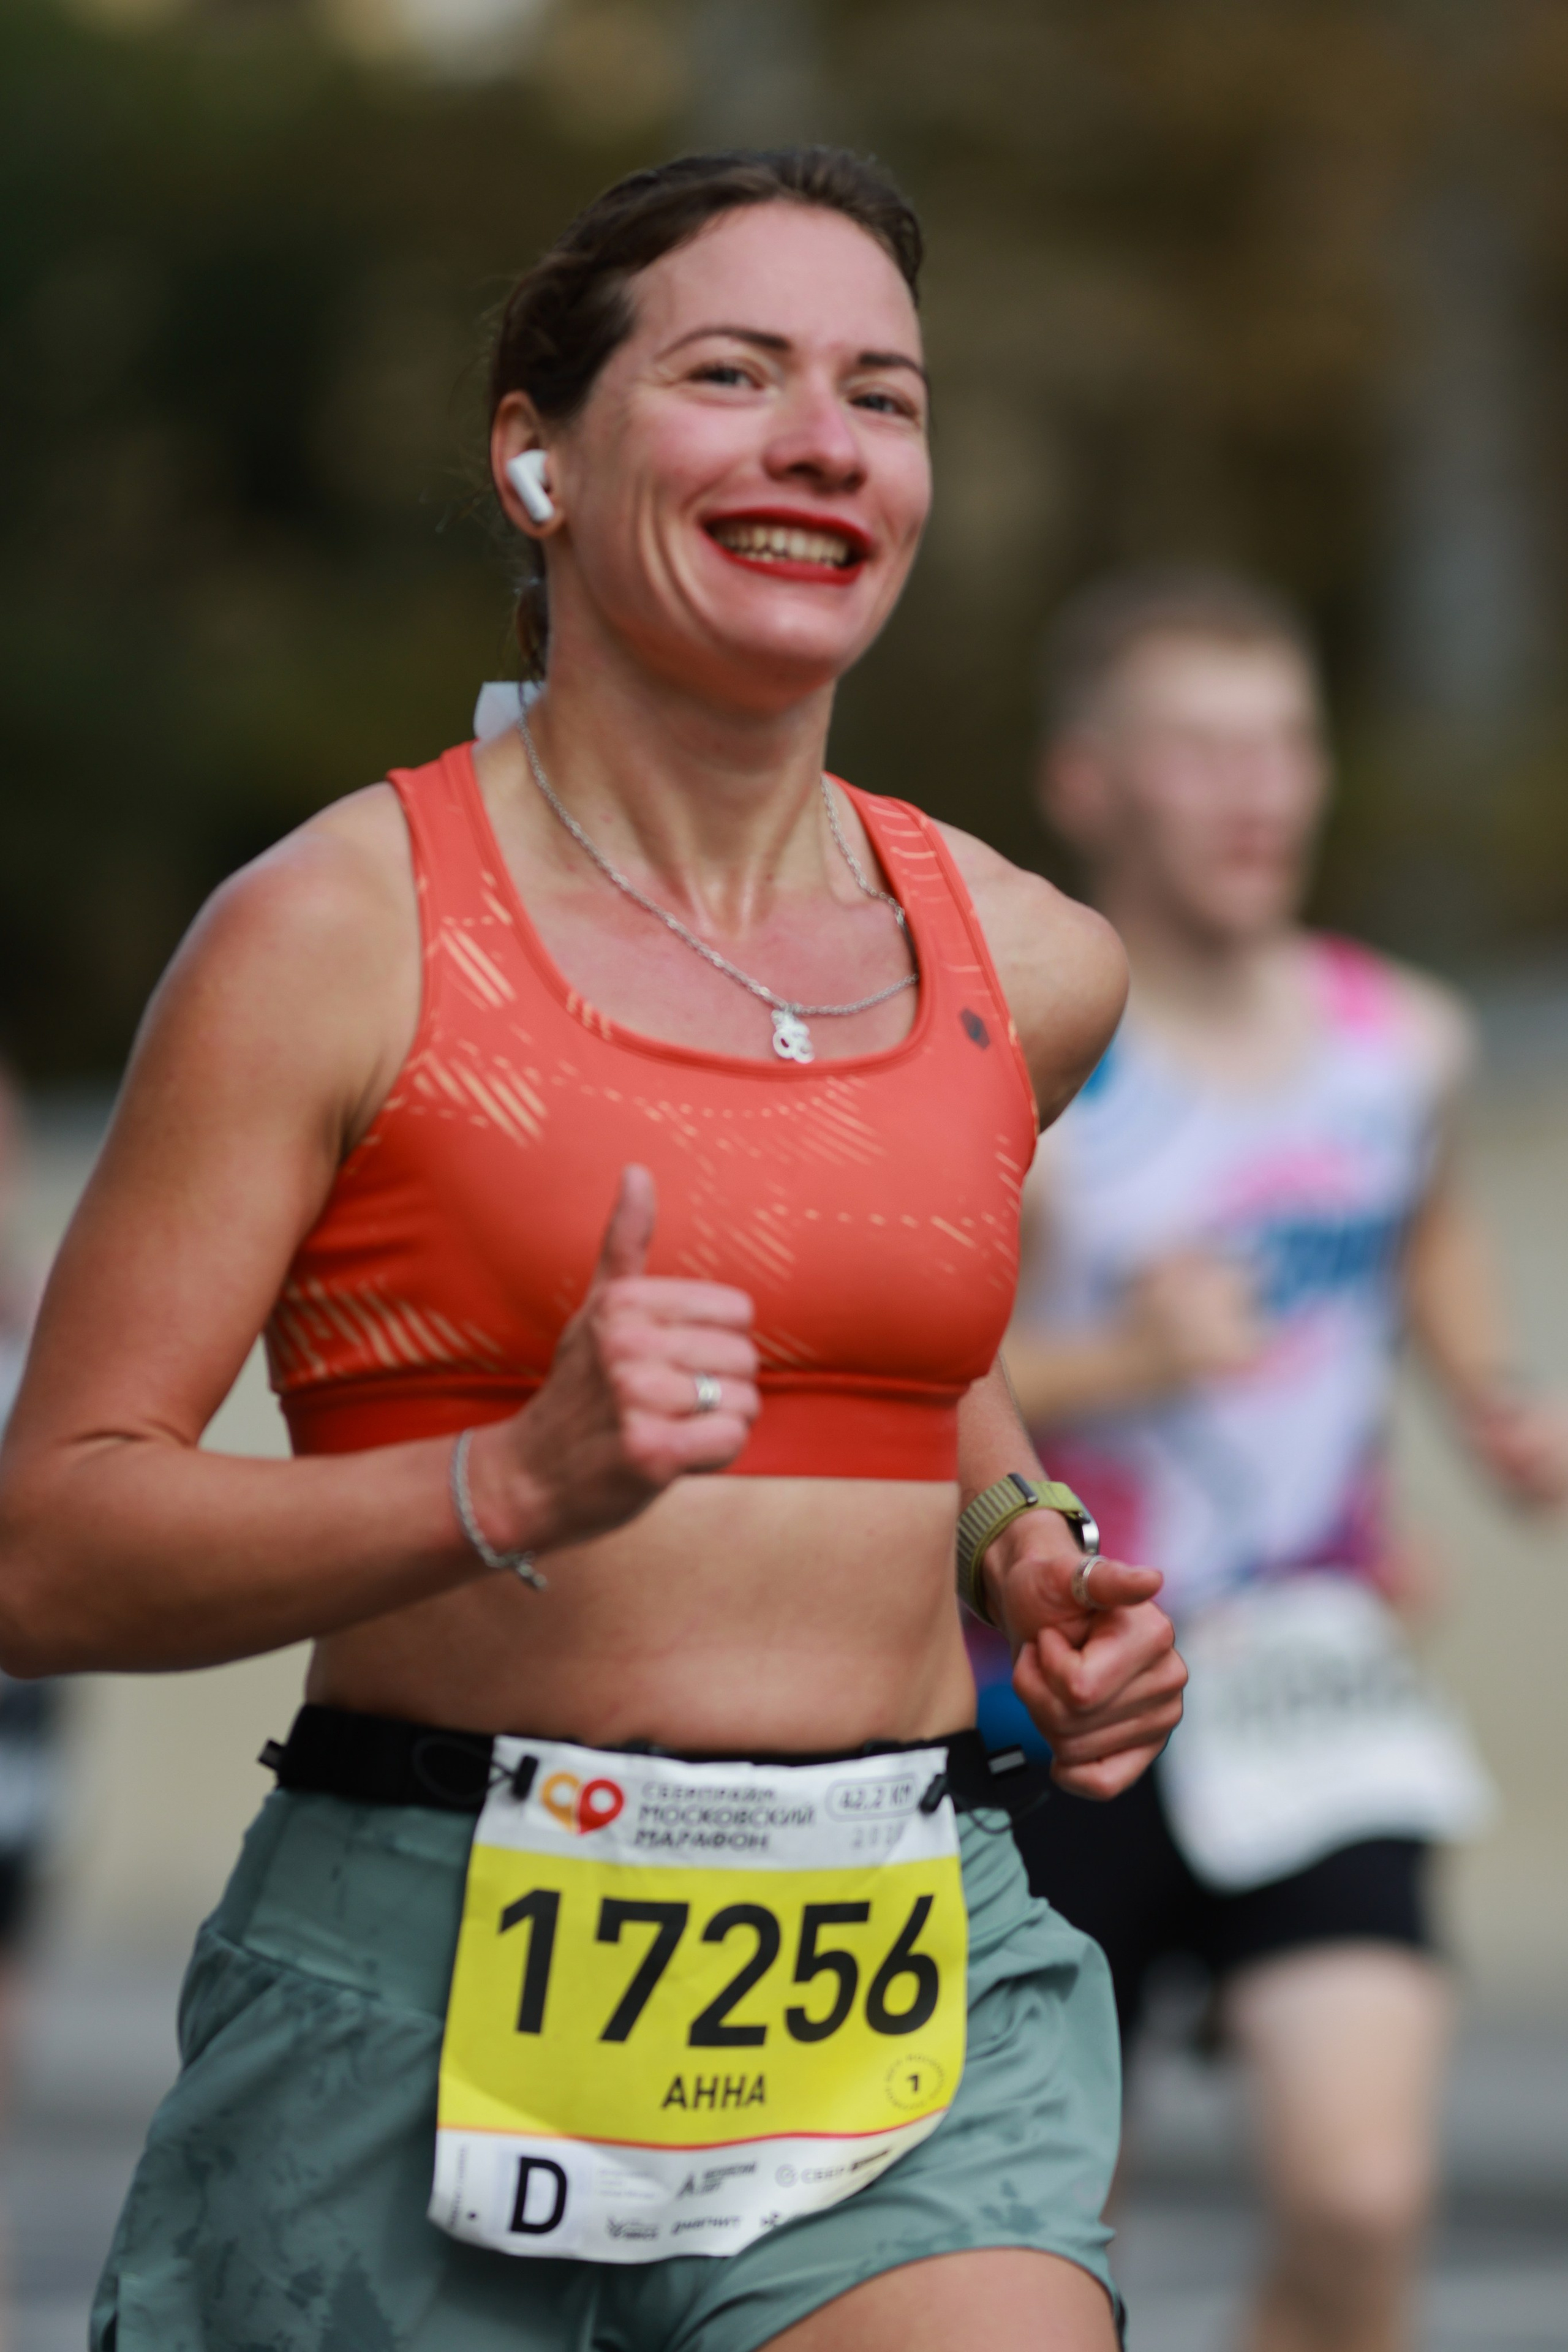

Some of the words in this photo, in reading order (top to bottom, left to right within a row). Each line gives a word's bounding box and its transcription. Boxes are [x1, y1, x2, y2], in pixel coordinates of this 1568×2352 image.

[497, 1888, 940, 2048] 17256
[662, 2074, 766, 2111] АННА
[907, 2073, 919, 2094] 1
[510, 2156, 568, 2234] D
